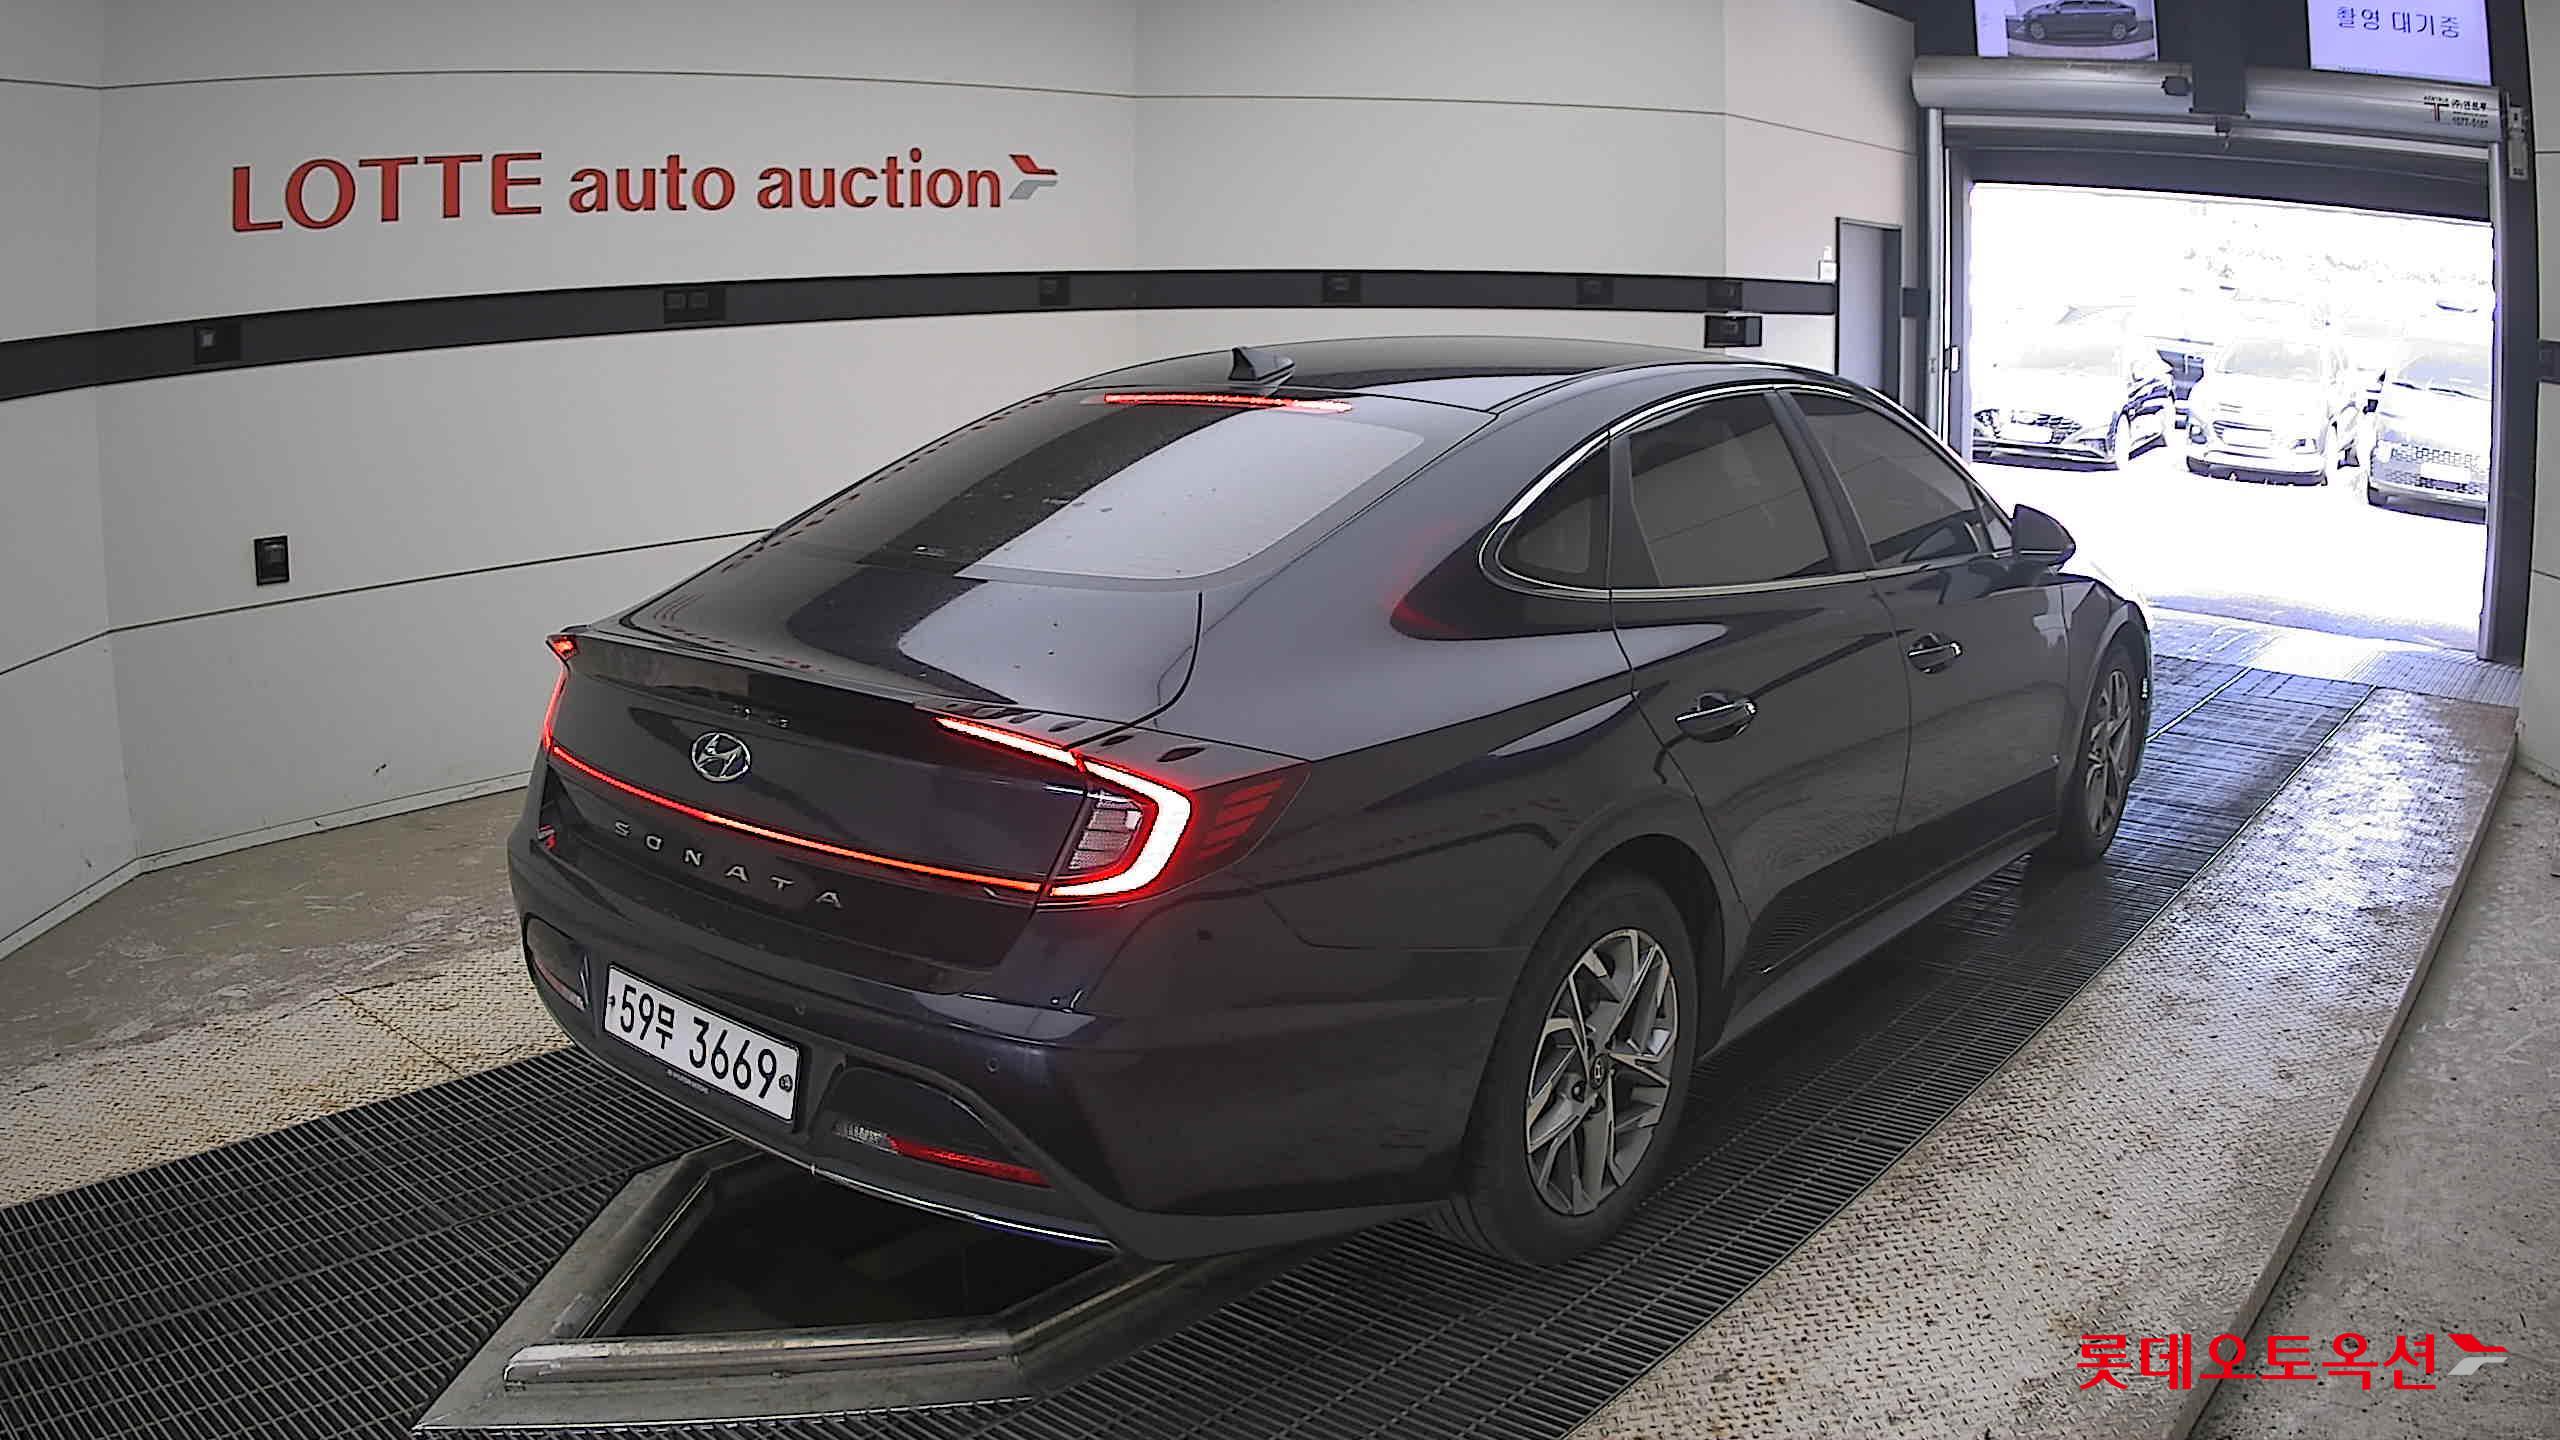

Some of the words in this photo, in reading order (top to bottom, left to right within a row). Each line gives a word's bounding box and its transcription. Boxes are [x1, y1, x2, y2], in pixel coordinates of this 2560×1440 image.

[2391, 11, 2460, 39] 대기중
[232, 151, 541, 233] LOTTE
[568, 154, 738, 213] auto
[757, 147, 1001, 209] auction
[615, 820, 843, 908] SONATA
[620, 984, 675, 1049] 59무
[689, 1016, 777, 1099] 3669
